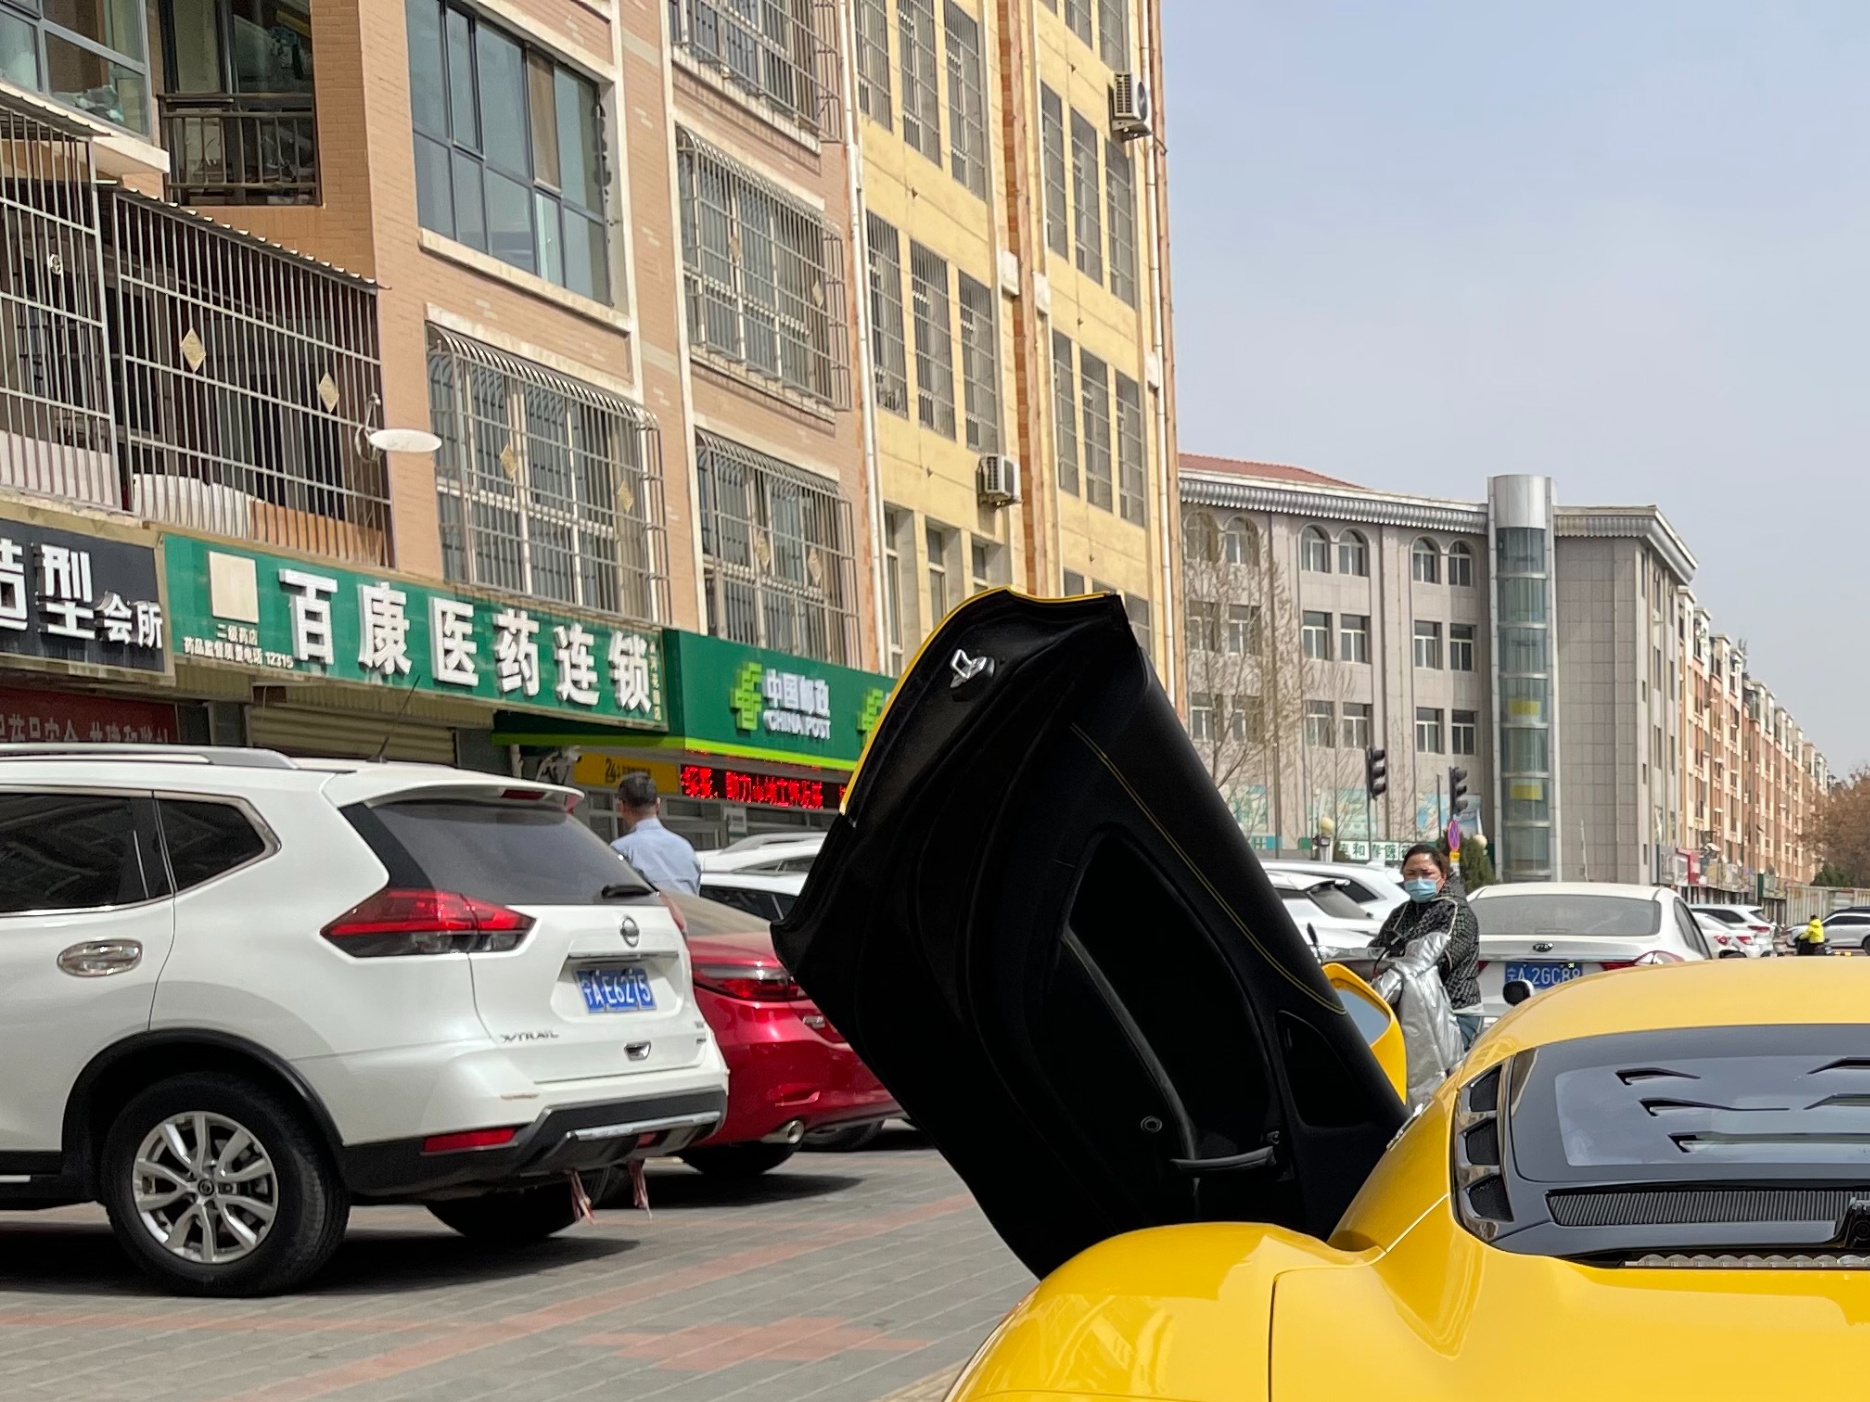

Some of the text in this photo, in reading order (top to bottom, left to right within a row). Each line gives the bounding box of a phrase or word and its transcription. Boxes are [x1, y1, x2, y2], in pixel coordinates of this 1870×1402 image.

[279, 568, 652, 714] 百康医药连锁
[763, 709, 831, 740] CHINA POST
